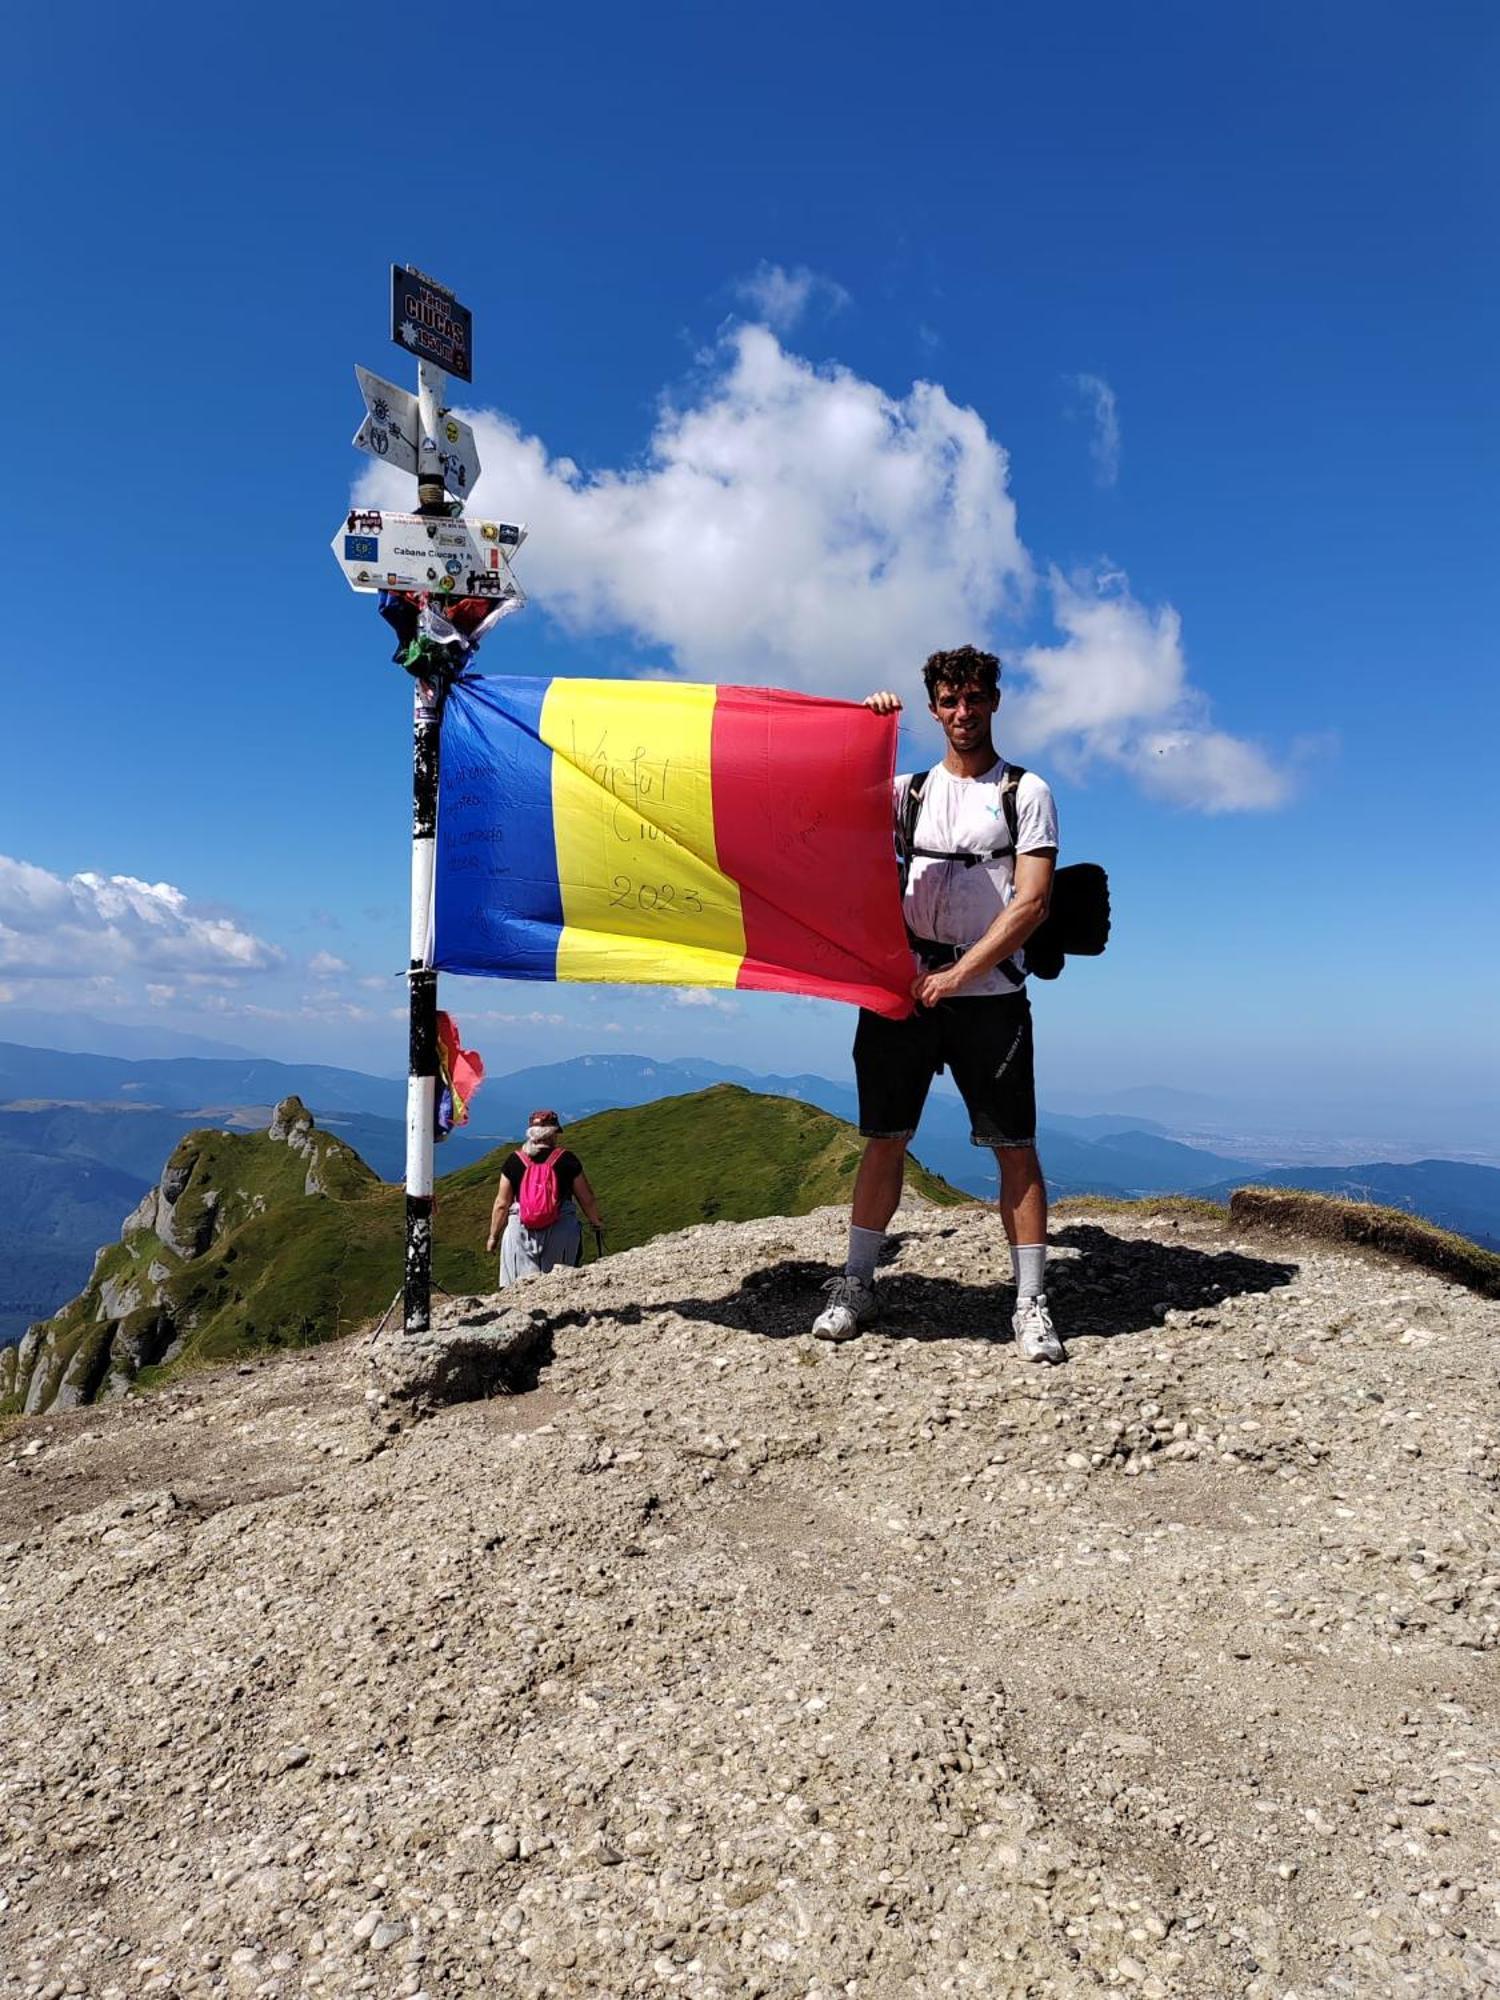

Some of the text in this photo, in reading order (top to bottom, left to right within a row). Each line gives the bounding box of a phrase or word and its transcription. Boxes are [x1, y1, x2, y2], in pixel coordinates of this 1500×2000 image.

[393, 547, 426, 557] Cabana
[571, 719, 669, 809] Vârful
[609, 875, 704, 913] 2023
